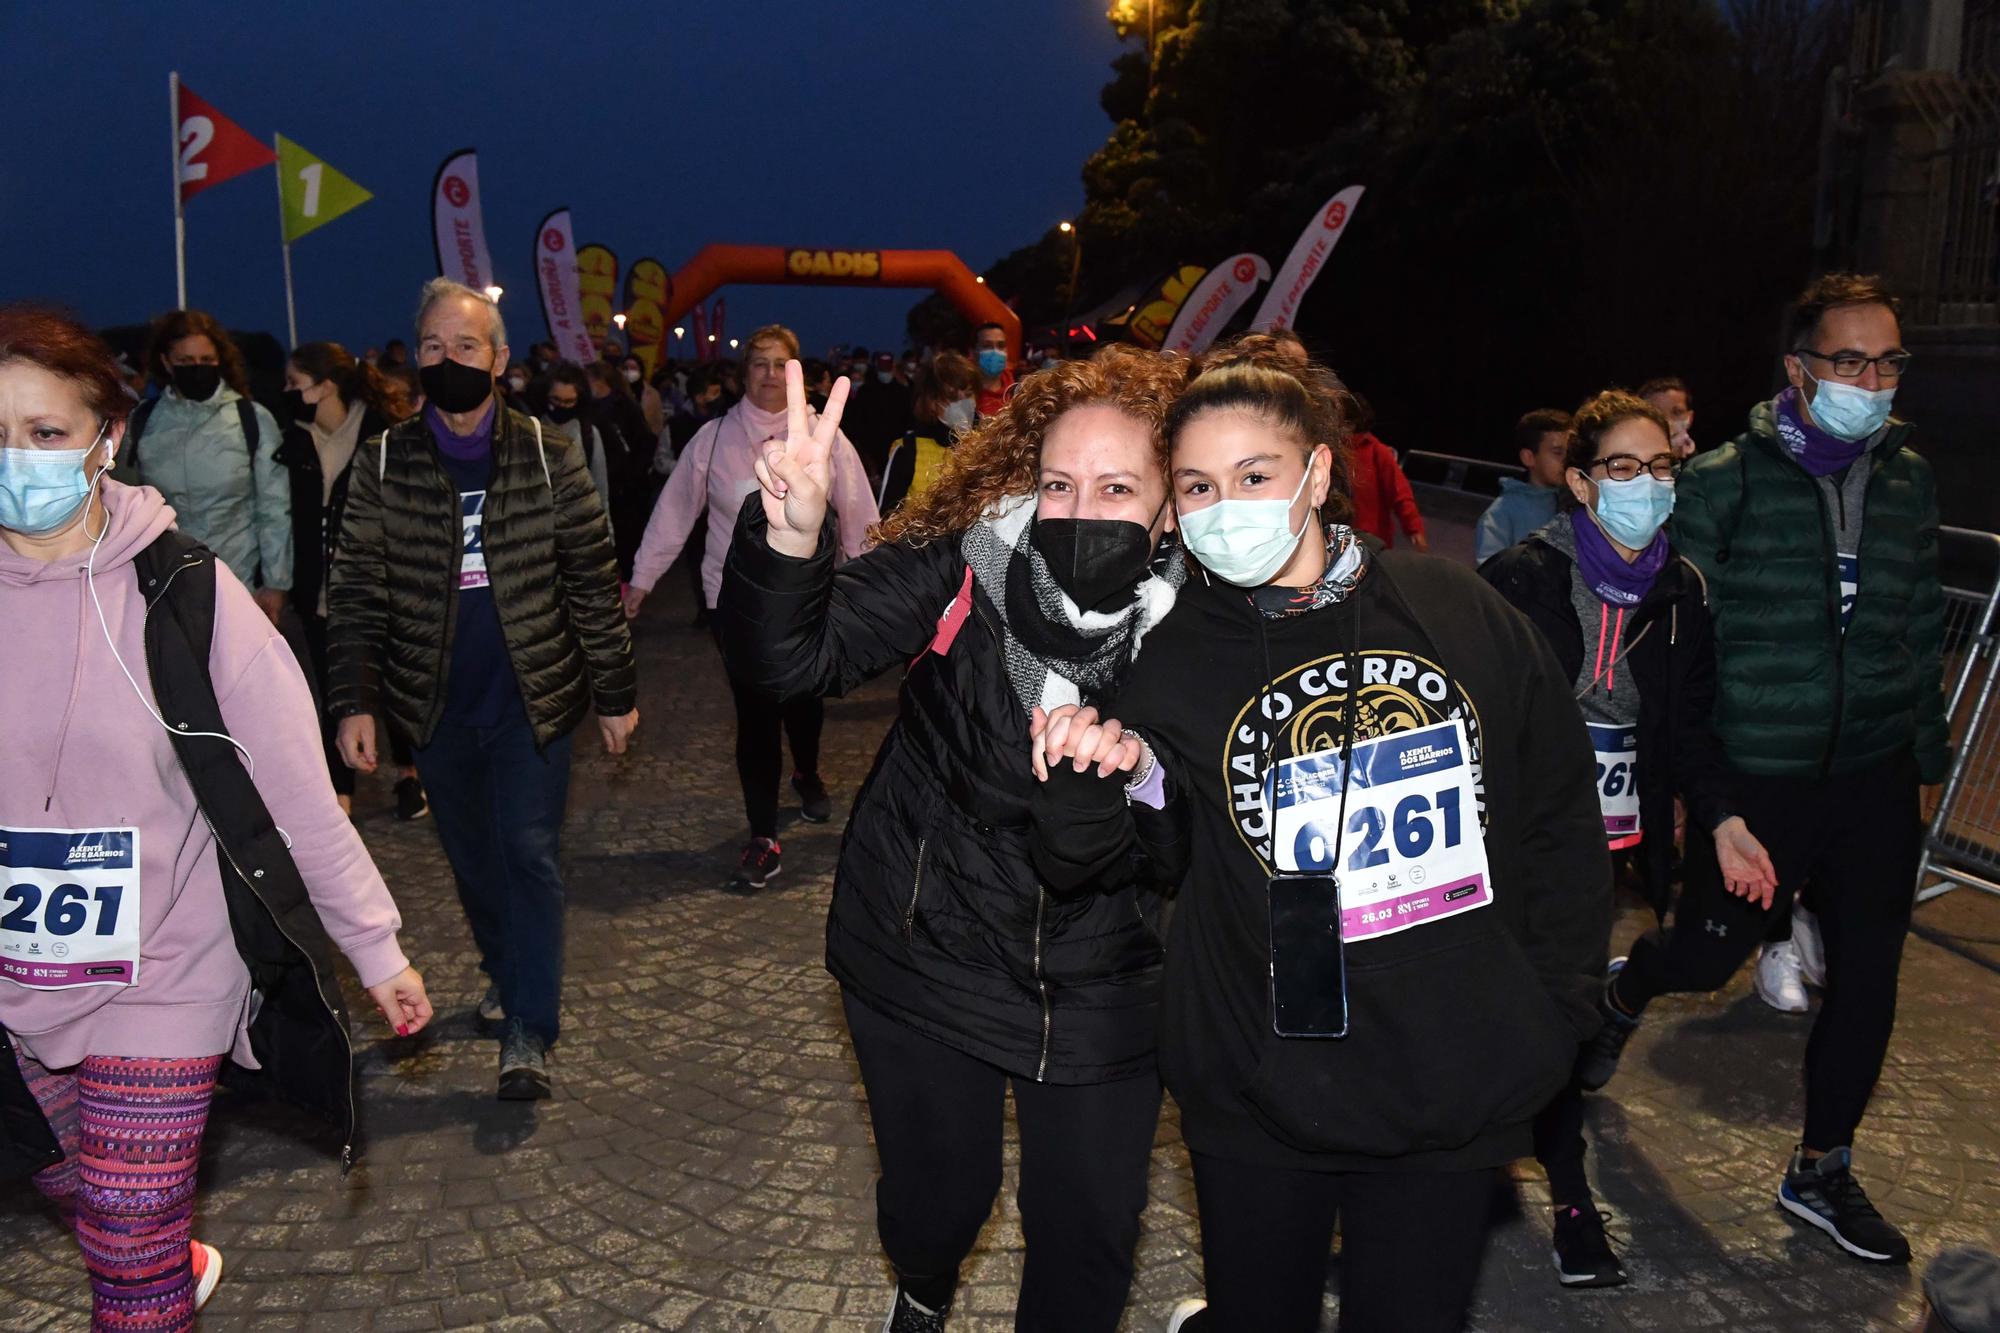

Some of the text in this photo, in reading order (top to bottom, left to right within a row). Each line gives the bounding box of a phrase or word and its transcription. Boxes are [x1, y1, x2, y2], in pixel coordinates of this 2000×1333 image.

[179, 115, 215, 183] 2
[298, 163, 322, 217] 1
[789, 249, 879, 277] GADIS
[1399, 745, 1433, 760] A XENTE
[1400, 747, 1454, 766] DOS BARRIOS
[1293, 785, 1461, 872] 0261
[68, 845, 104, 854] A XENTE
[87, 850, 125, 858] BARRIOS
[1361, 908, 1393, 924] 26.03
[3, 964, 29, 976] 26.03
